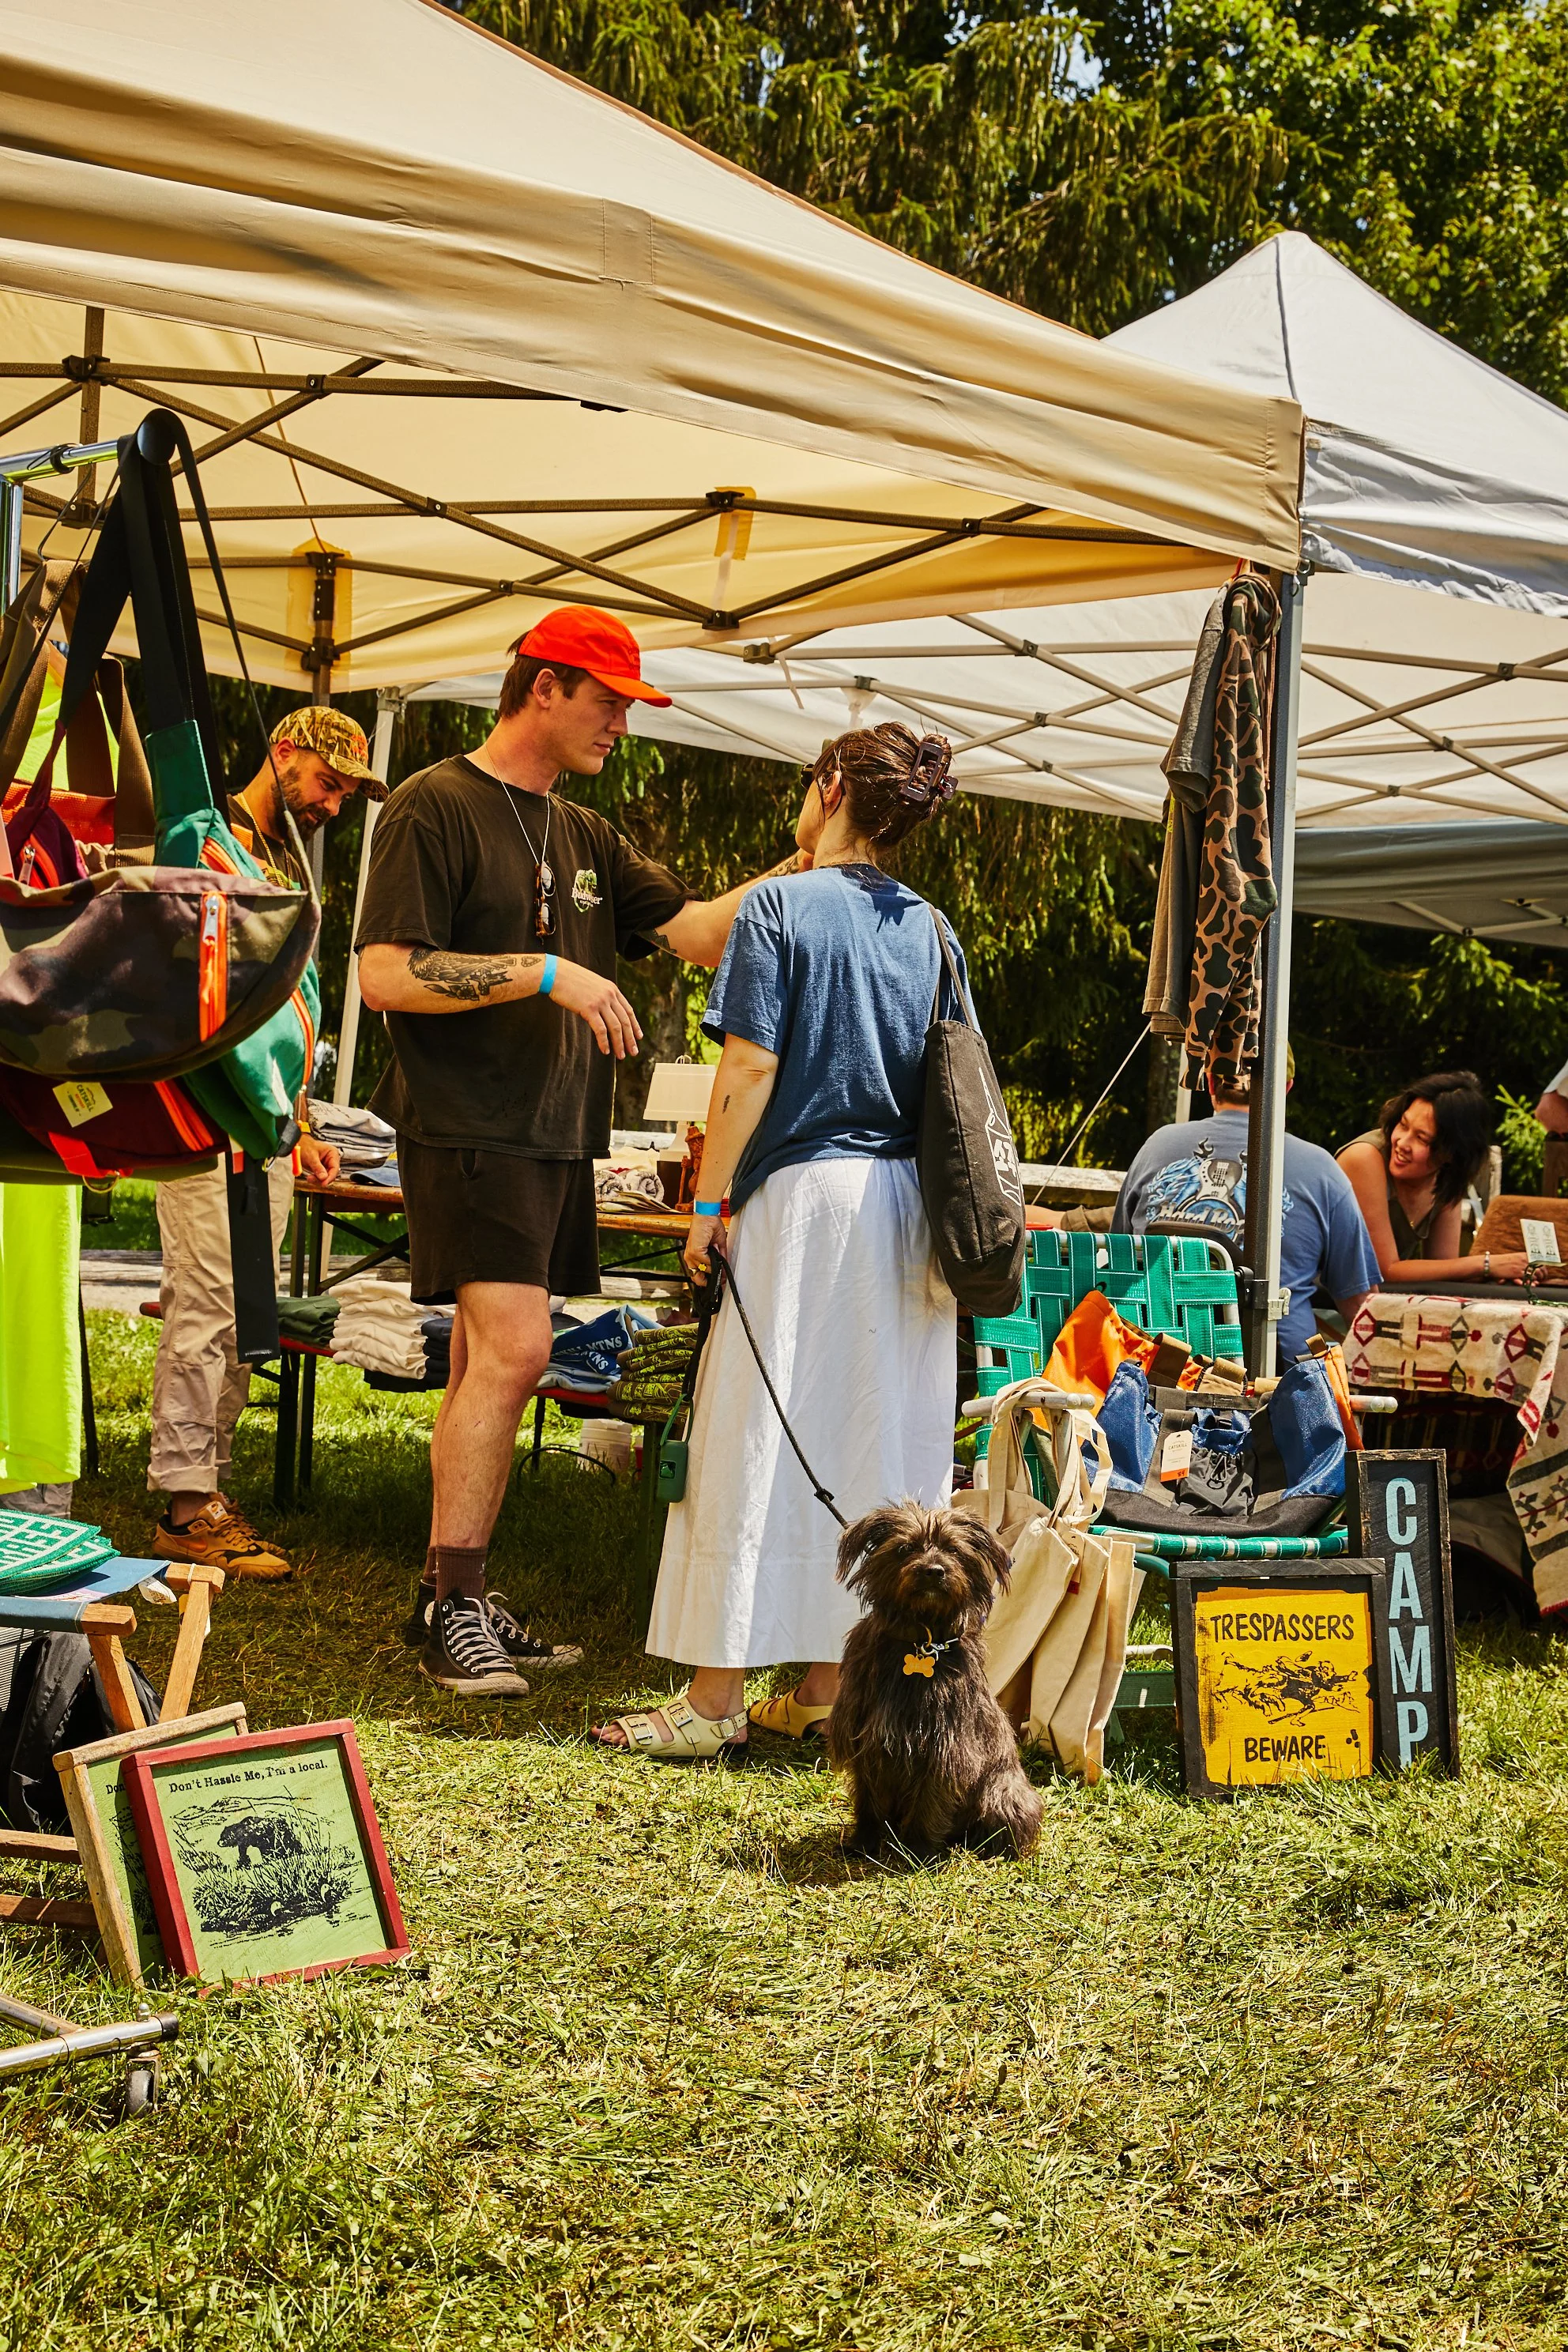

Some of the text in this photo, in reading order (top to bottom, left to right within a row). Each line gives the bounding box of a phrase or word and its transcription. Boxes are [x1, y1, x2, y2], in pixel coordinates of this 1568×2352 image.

[571, 887, 603, 905] Budwser
[1158, 1200, 1246, 1234] Hard Roc
[586, 1336, 623, 1351] MTNS
[1210, 1613, 1355, 1643] TRESPASSERS
[1385, 1477, 1433, 1768] CAMP
[1244, 1735, 1326, 1762] BEWARE
[105, 1782, 126, 1795] Don
[169, 1759, 329, 1793] Don't Hassle Me, I'm a local.
